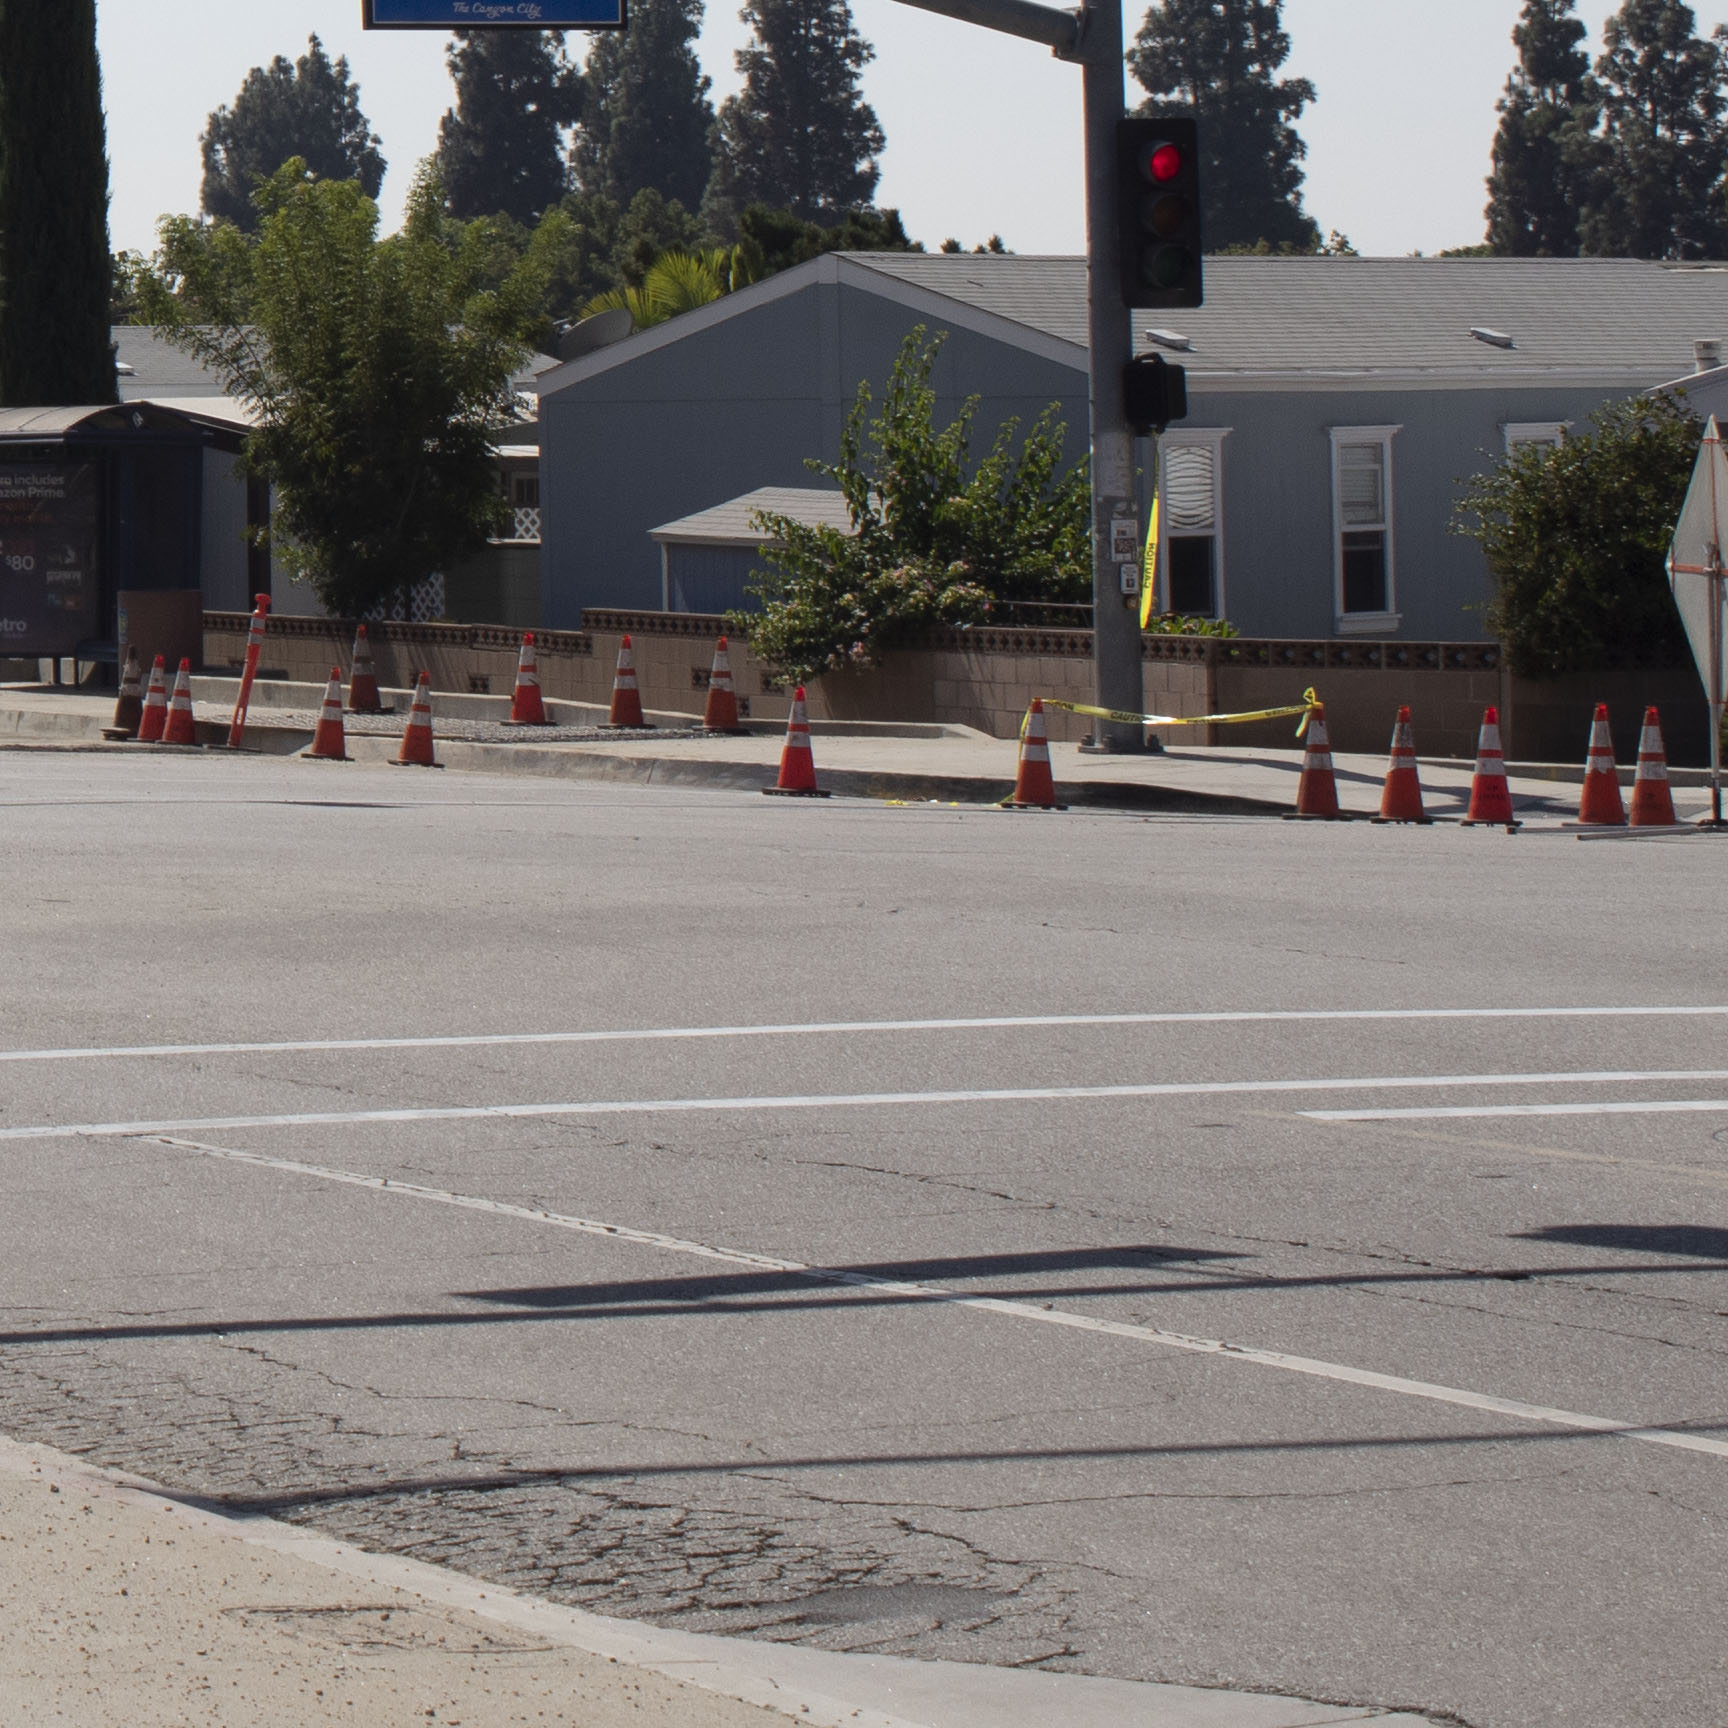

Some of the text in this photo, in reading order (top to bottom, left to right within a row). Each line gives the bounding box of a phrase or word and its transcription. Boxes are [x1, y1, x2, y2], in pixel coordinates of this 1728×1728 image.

[453, 2, 542, 19] The Canyon City
[14, 473, 65, 485] includes
